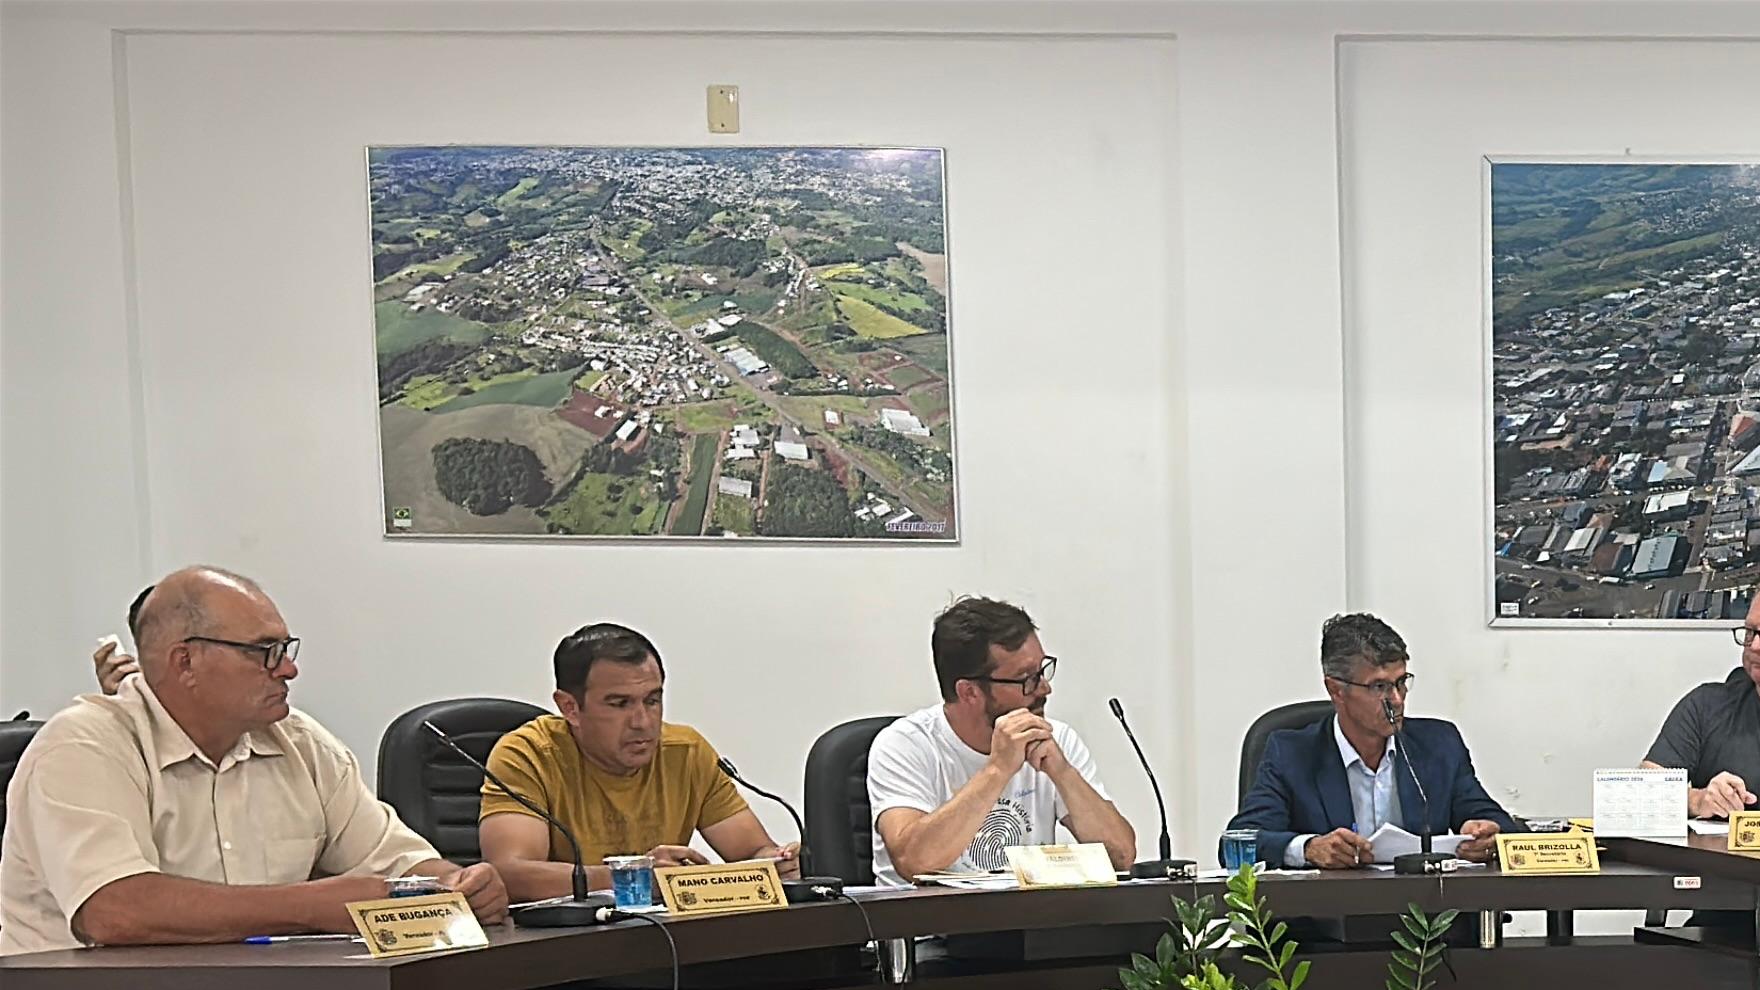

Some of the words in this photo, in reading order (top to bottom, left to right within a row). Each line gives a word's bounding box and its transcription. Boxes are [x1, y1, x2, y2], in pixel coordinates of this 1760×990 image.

[677, 878, 708, 887] MANO
[710, 874, 764, 885] CARVALHO
[374, 914, 398, 923] ADE
[400, 908, 453, 920] BUGANÇA
